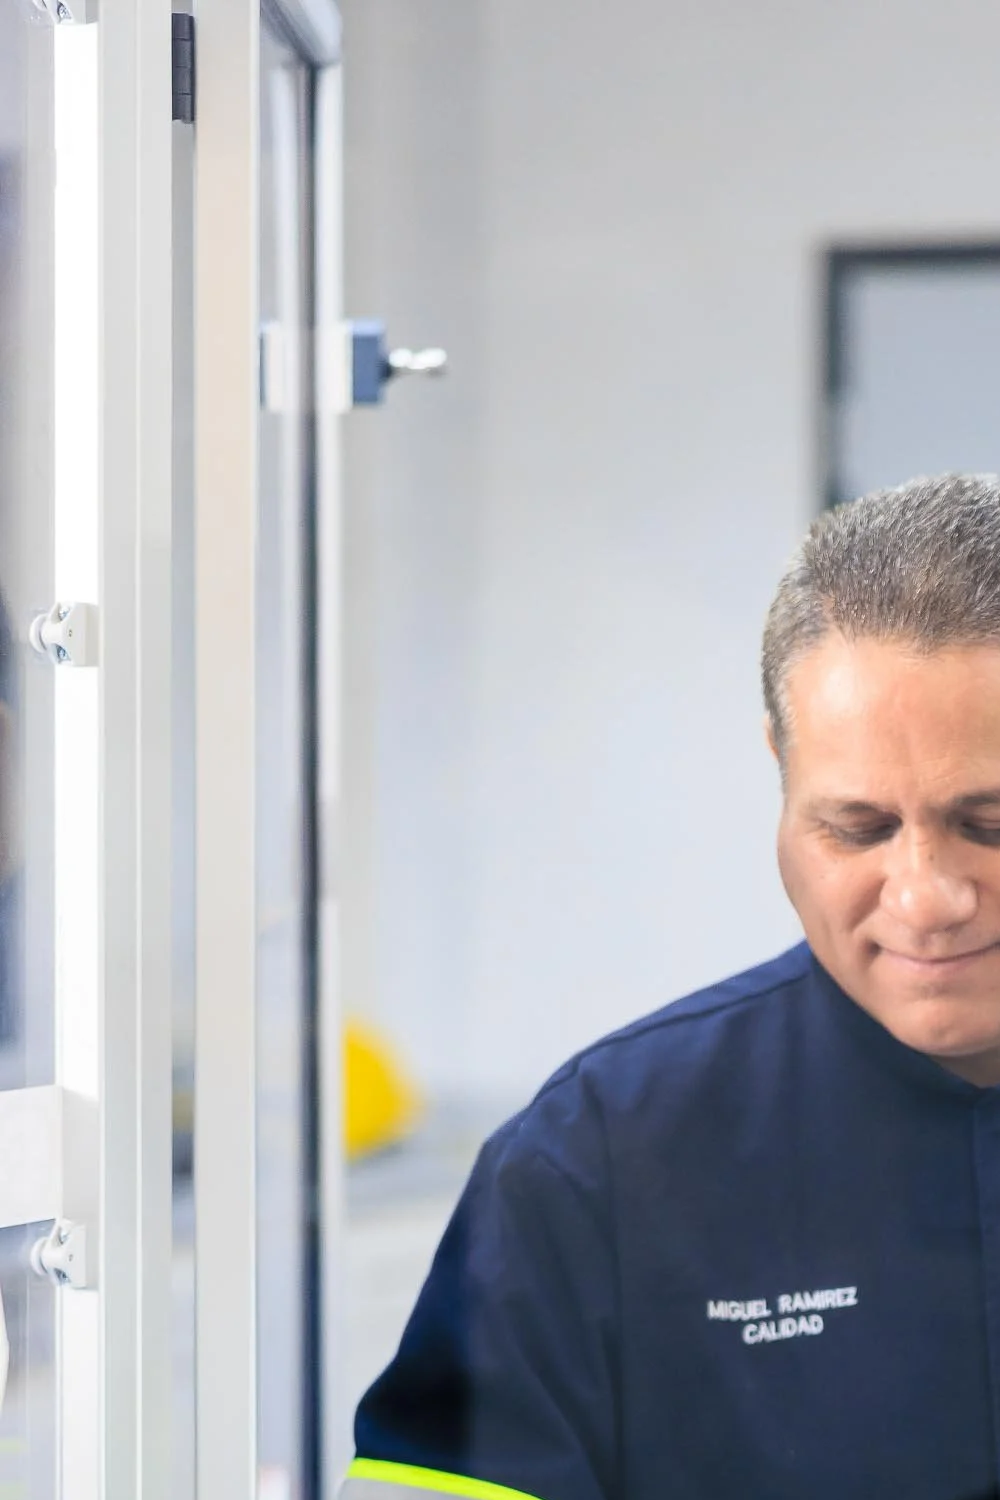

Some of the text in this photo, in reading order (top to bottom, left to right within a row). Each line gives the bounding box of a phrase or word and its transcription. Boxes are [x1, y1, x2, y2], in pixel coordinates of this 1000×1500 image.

[706, 1285, 859, 1322] MIGUEL RAMIREZ
[742, 1313, 824, 1345] CALIDAD
